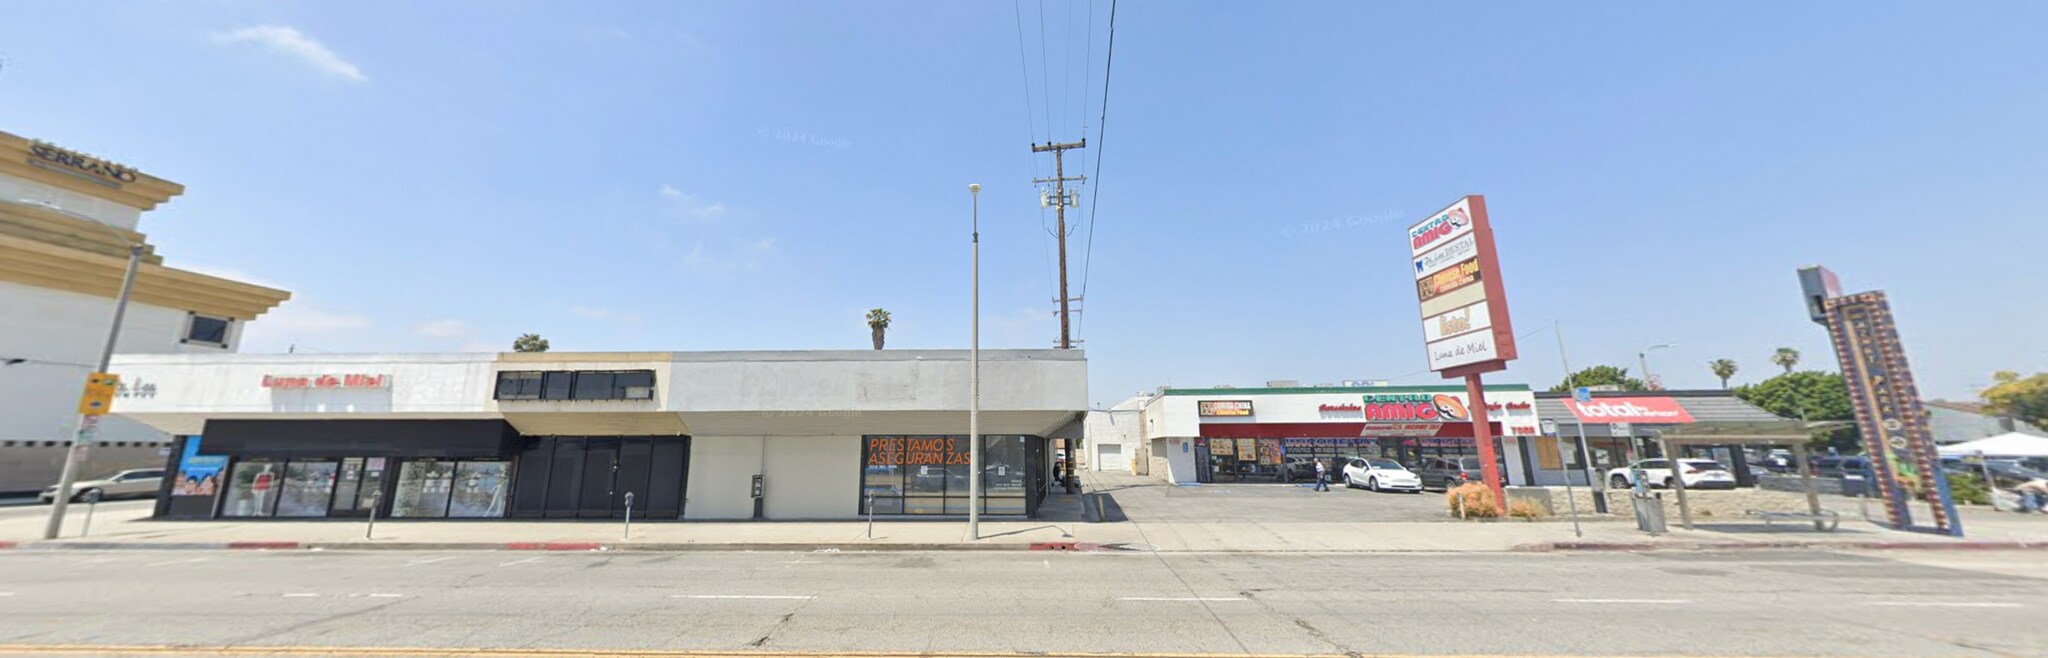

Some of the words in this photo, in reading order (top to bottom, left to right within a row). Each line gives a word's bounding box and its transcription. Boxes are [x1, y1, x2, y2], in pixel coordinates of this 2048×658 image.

[29, 144, 136, 183] SERRANO
[1445, 238, 1474, 256] DENTAL
[1455, 346, 1465, 356] de
[1467, 341, 1488, 354] Miel
[314, 374, 340, 388] de
[344, 374, 385, 388] Miel
[1576, 401, 1640, 417] total
[870, 438, 955, 452] PRESTAMOS
